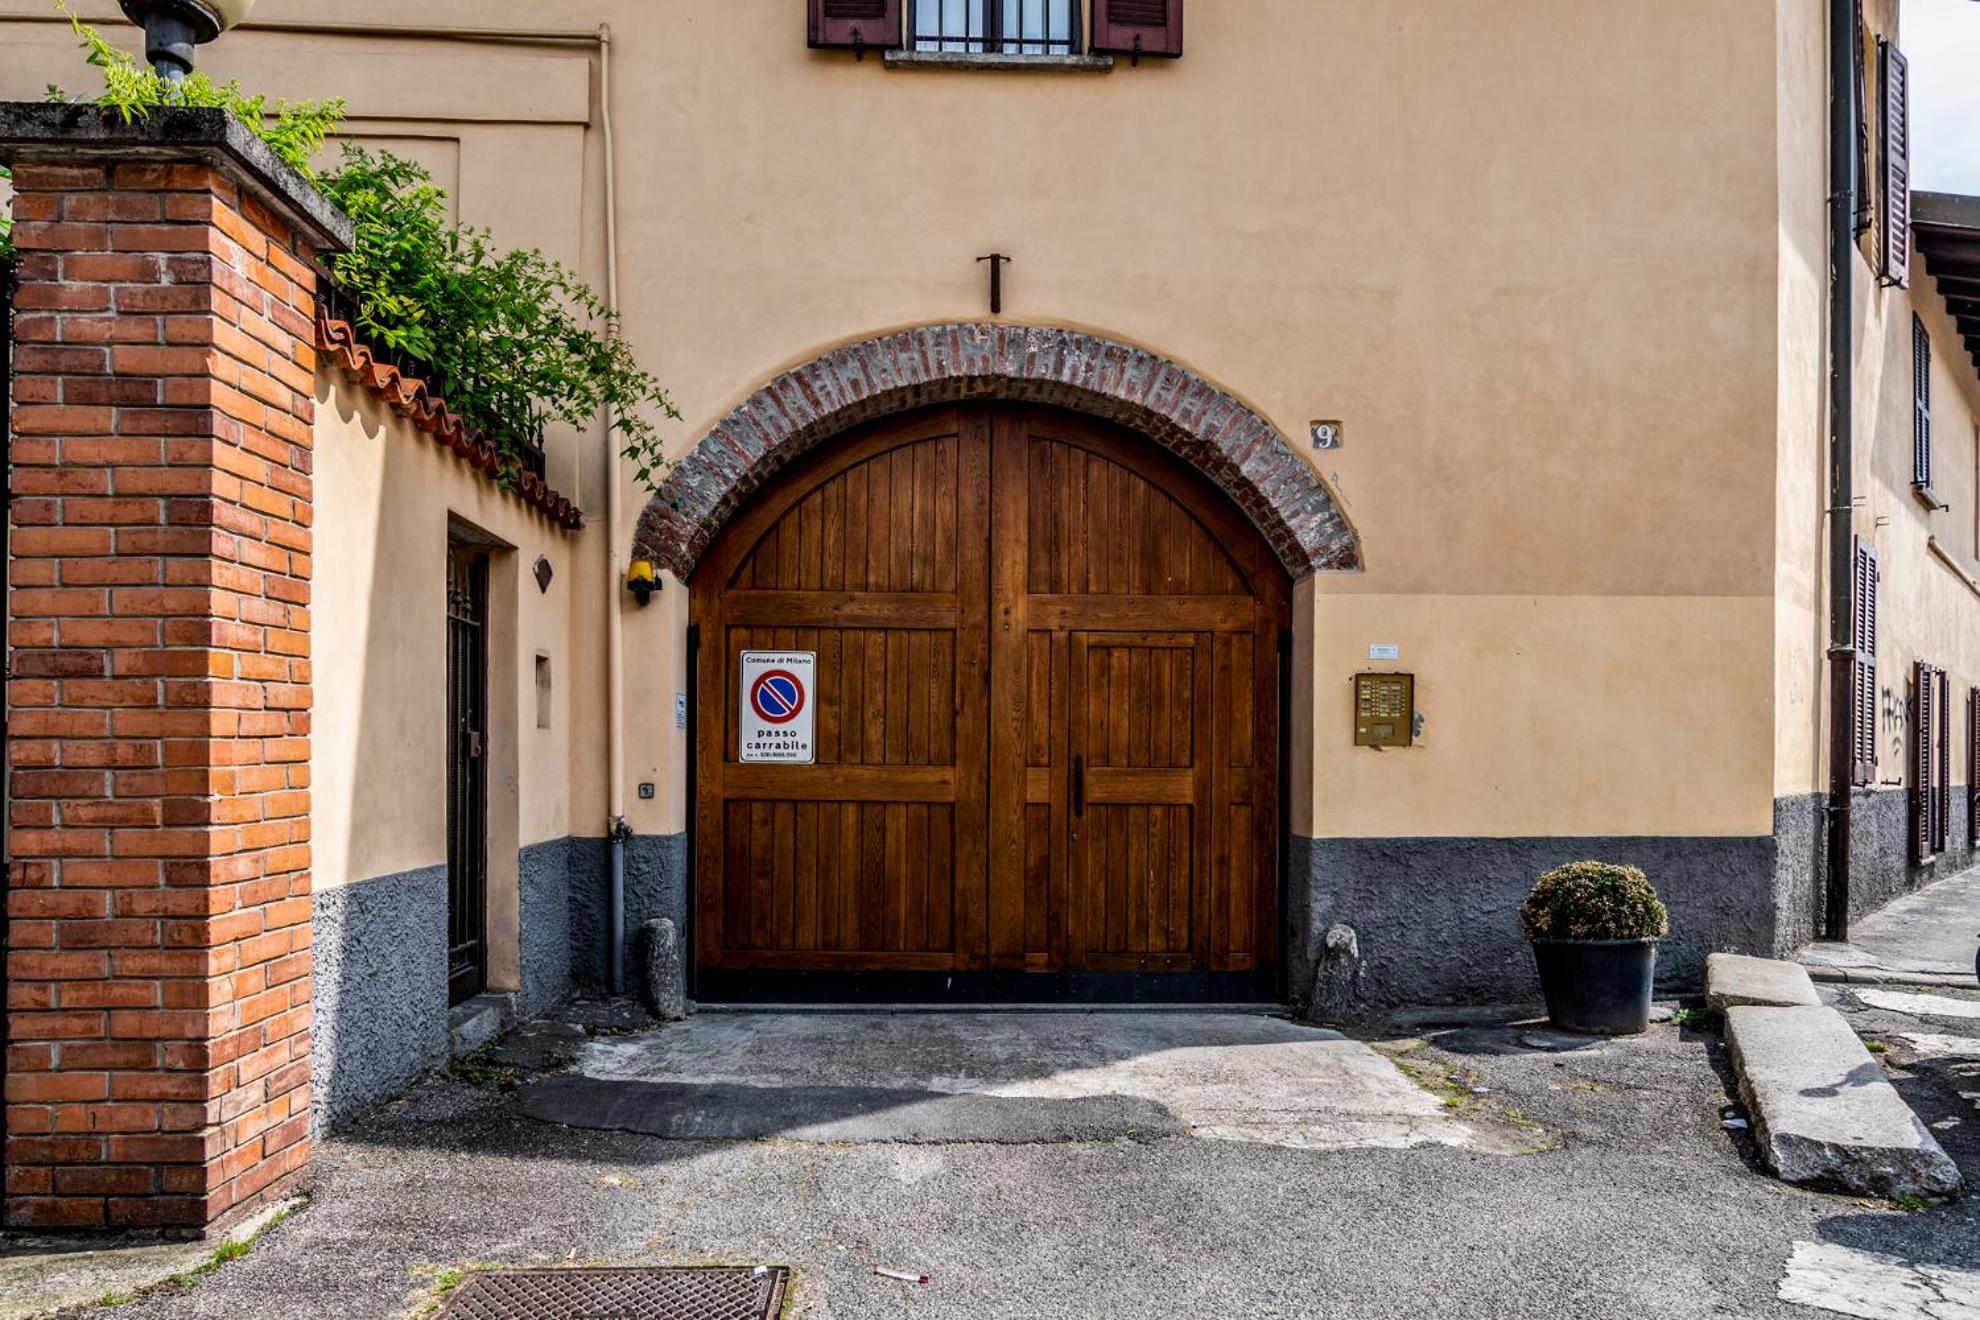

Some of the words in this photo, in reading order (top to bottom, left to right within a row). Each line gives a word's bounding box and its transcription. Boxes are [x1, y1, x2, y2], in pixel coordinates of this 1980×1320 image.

[1317, 424, 1332, 449] 9
[786, 657, 811, 665] Milano
[757, 729, 797, 738] passo
[746, 741, 808, 751] carrabile
